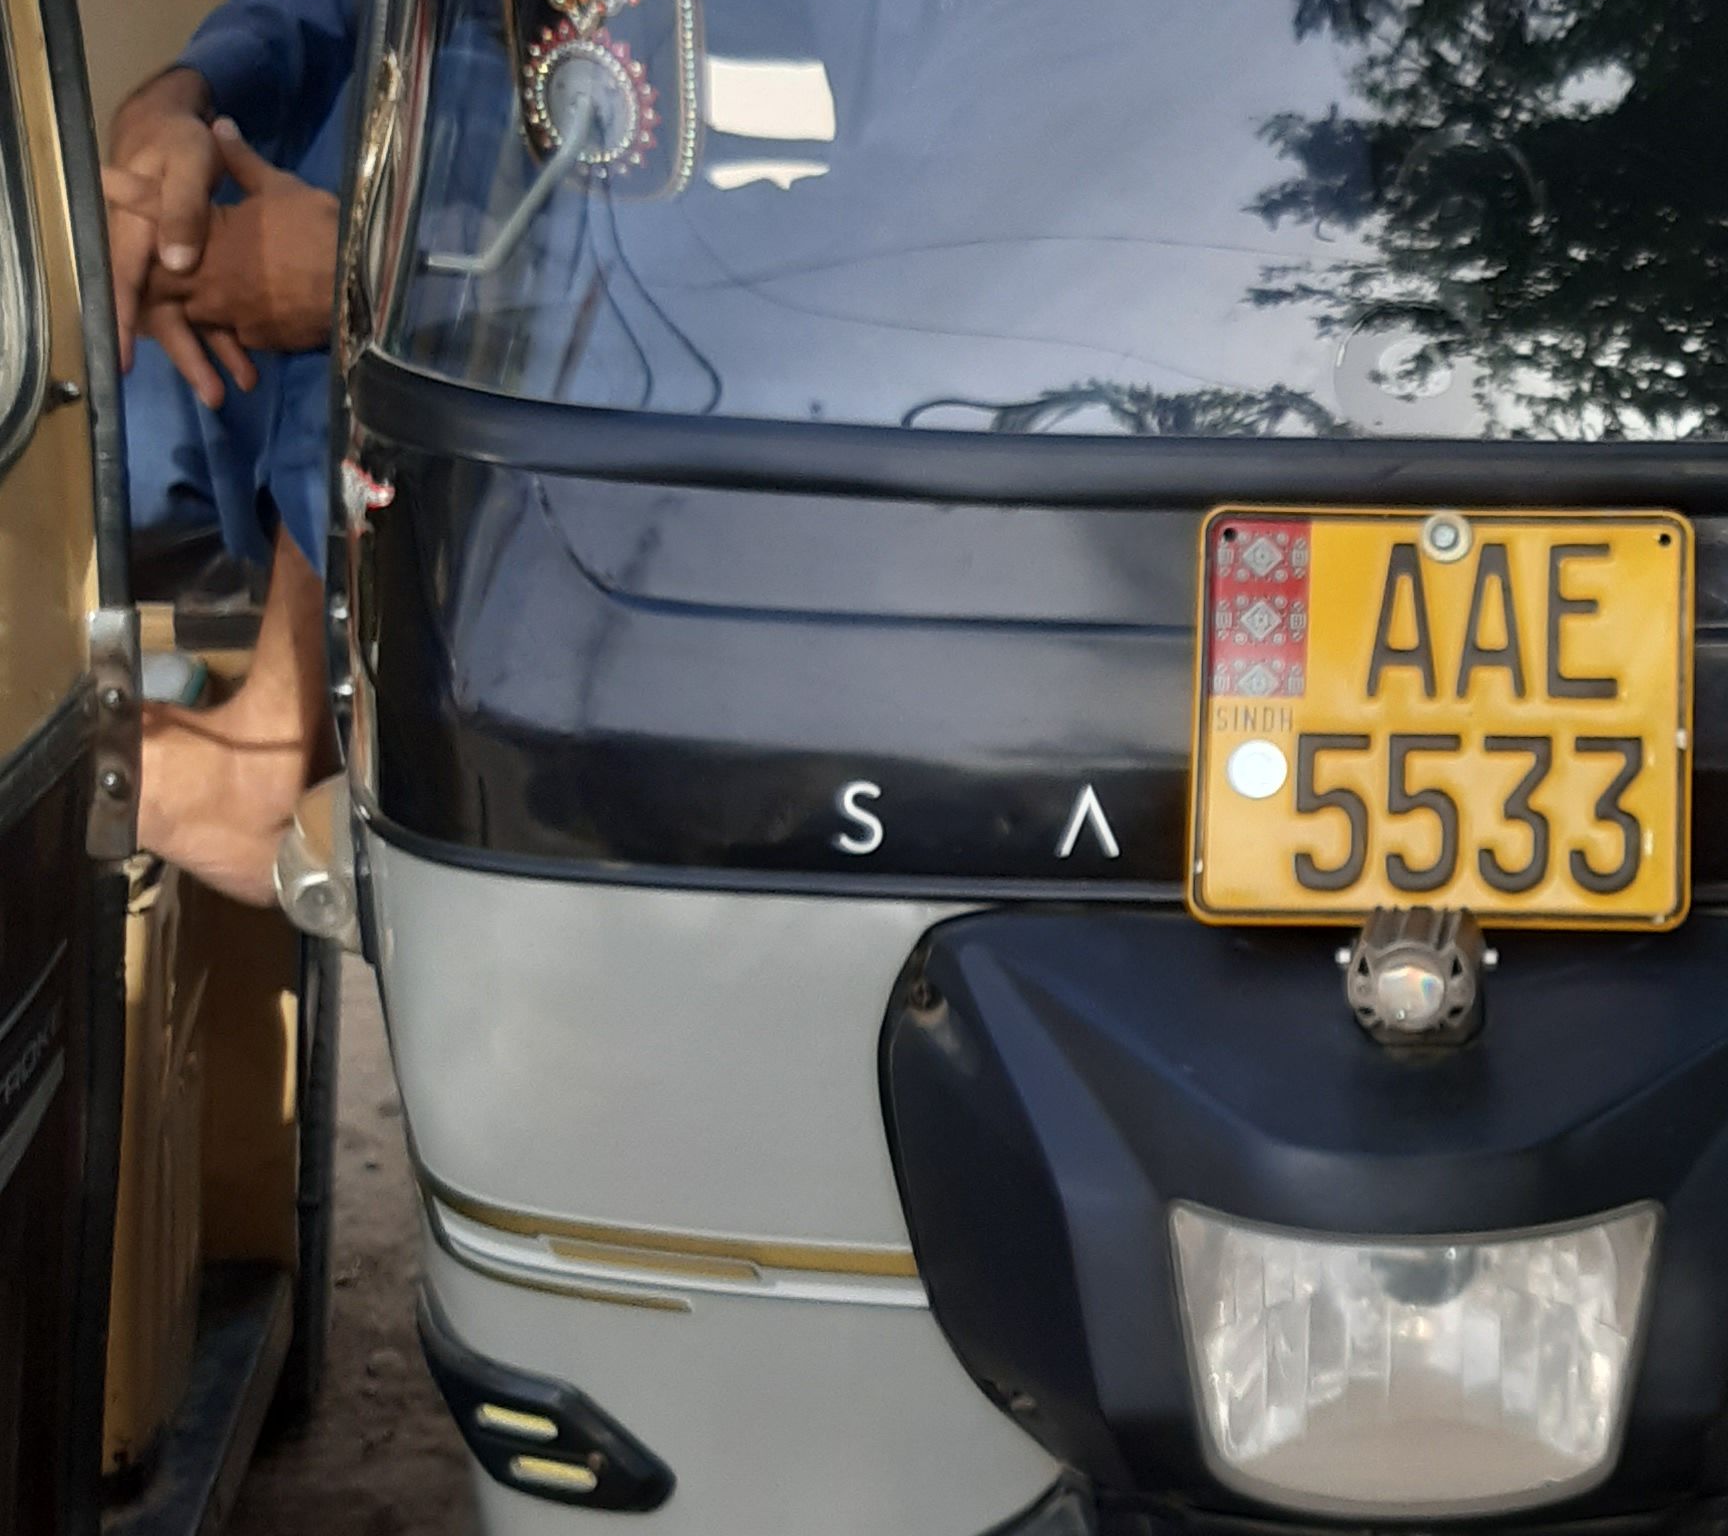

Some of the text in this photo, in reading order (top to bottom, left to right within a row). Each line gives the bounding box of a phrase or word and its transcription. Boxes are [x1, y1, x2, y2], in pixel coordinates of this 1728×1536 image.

[1366, 542, 1619, 699] AAE
[1216, 706, 1294, 732] SINDH
[1293, 732, 1643, 894] 5533
